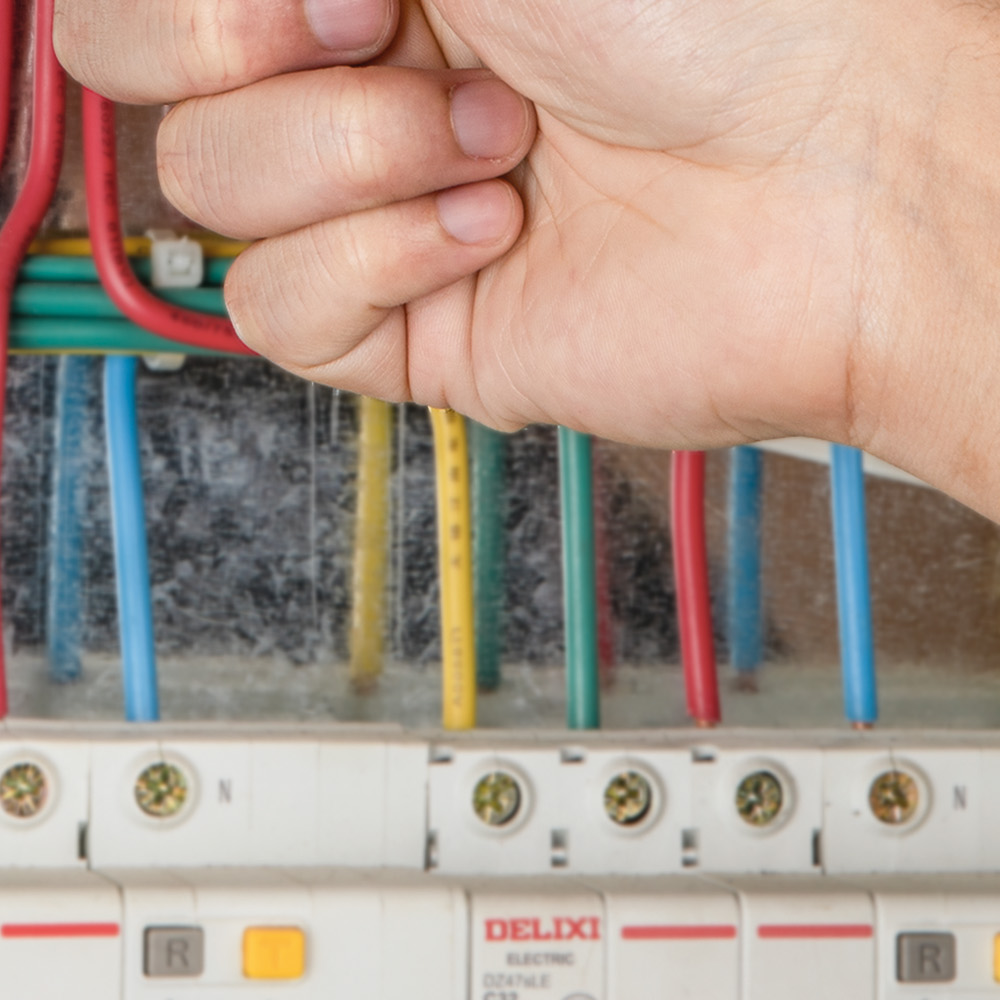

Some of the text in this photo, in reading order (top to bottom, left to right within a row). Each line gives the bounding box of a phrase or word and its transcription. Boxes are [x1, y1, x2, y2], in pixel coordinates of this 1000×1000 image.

[219, 778, 232, 804] N
[953, 784, 968, 810] N
[484, 916, 601, 942] DELIXI
[166, 937, 190, 968] R
[505, 951, 574, 967] ELECTRIC
[919, 943, 942, 974] R
